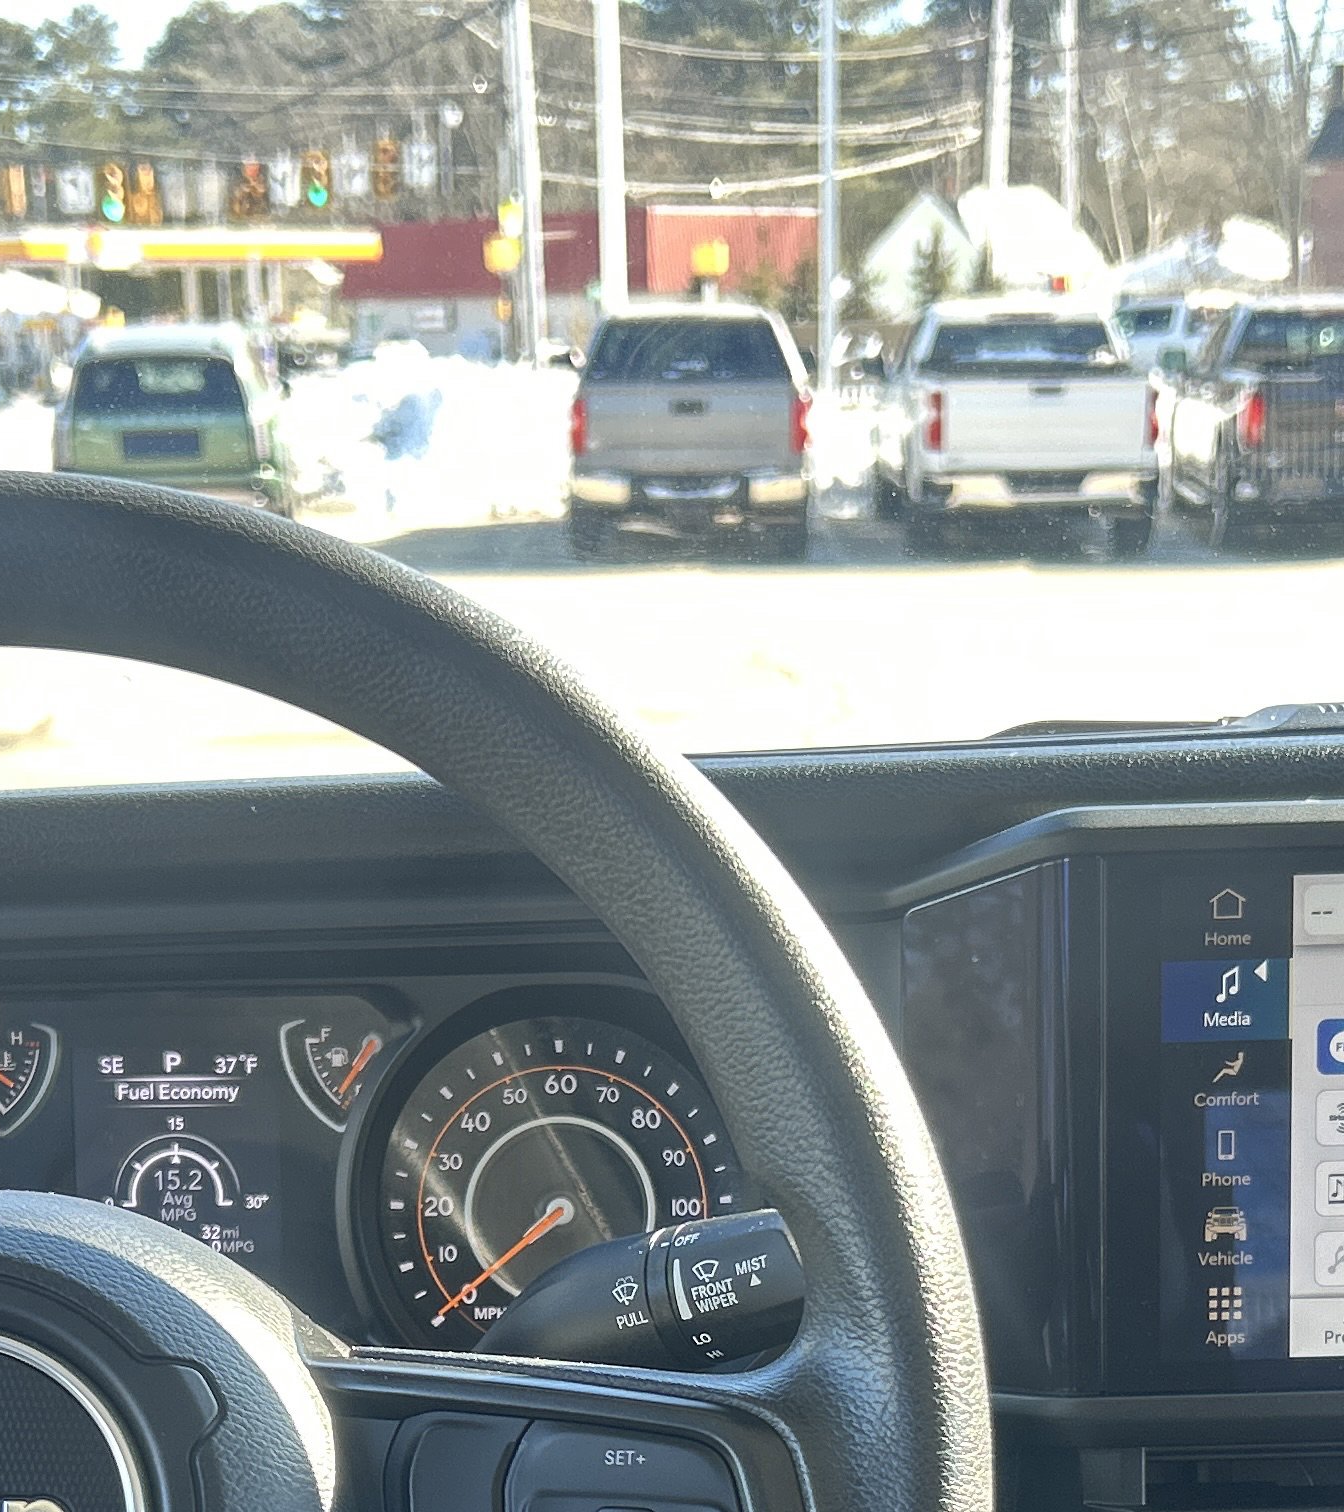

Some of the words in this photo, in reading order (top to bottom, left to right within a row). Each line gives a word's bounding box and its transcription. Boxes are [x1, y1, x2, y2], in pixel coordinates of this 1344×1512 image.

[1204, 931, 1252, 946] Home
[1203, 1011, 1251, 1027] Media
[10, 1031, 23, 1045] H
[98, 1056, 124, 1074] SE
[163, 1051, 182, 1073] P
[544, 1074, 577, 1094] 60
[117, 1083, 154, 1101] Fuel
[158, 1083, 240, 1103] Economy
[502, 1088, 528, 1104] 50
[595, 1087, 620, 1103] 70
[1194, 1090, 1260, 1107] Comfort
[167, 1116, 185, 1131] 15
[460, 1111, 491, 1132] 40
[631, 1109, 662, 1129] 80
[438, 1153, 463, 1171] 30
[661, 1149, 686, 1167] 90
[154, 1169, 203, 1191] 15.2
[1201, 1172, 1251, 1187] Phone
[162, 1191, 194, 1208] Avg
[424, 1196, 454, 1217] 20
[670, 1199, 701, 1217] 100
[161, 1209, 197, 1221] MPG
[222, 1226, 240, 1239] mi
[674, 1232, 701, 1247] OFF
[222, 1241, 255, 1253] MPG
[439, 1244, 458, 1262] 10
[734, 1254, 768, 1276] MIST
[1197, 1251, 1254, 1266] Vehicle
[690, 1277, 733, 1301] FRONT
[694, 1291, 739, 1314] WIPER
[615, 1310, 649, 1330] PULL
[692, 1332, 712, 1346] LO
[1205, 1330, 1246, 1347] Apps
[705, 1348, 725, 1360] HI
